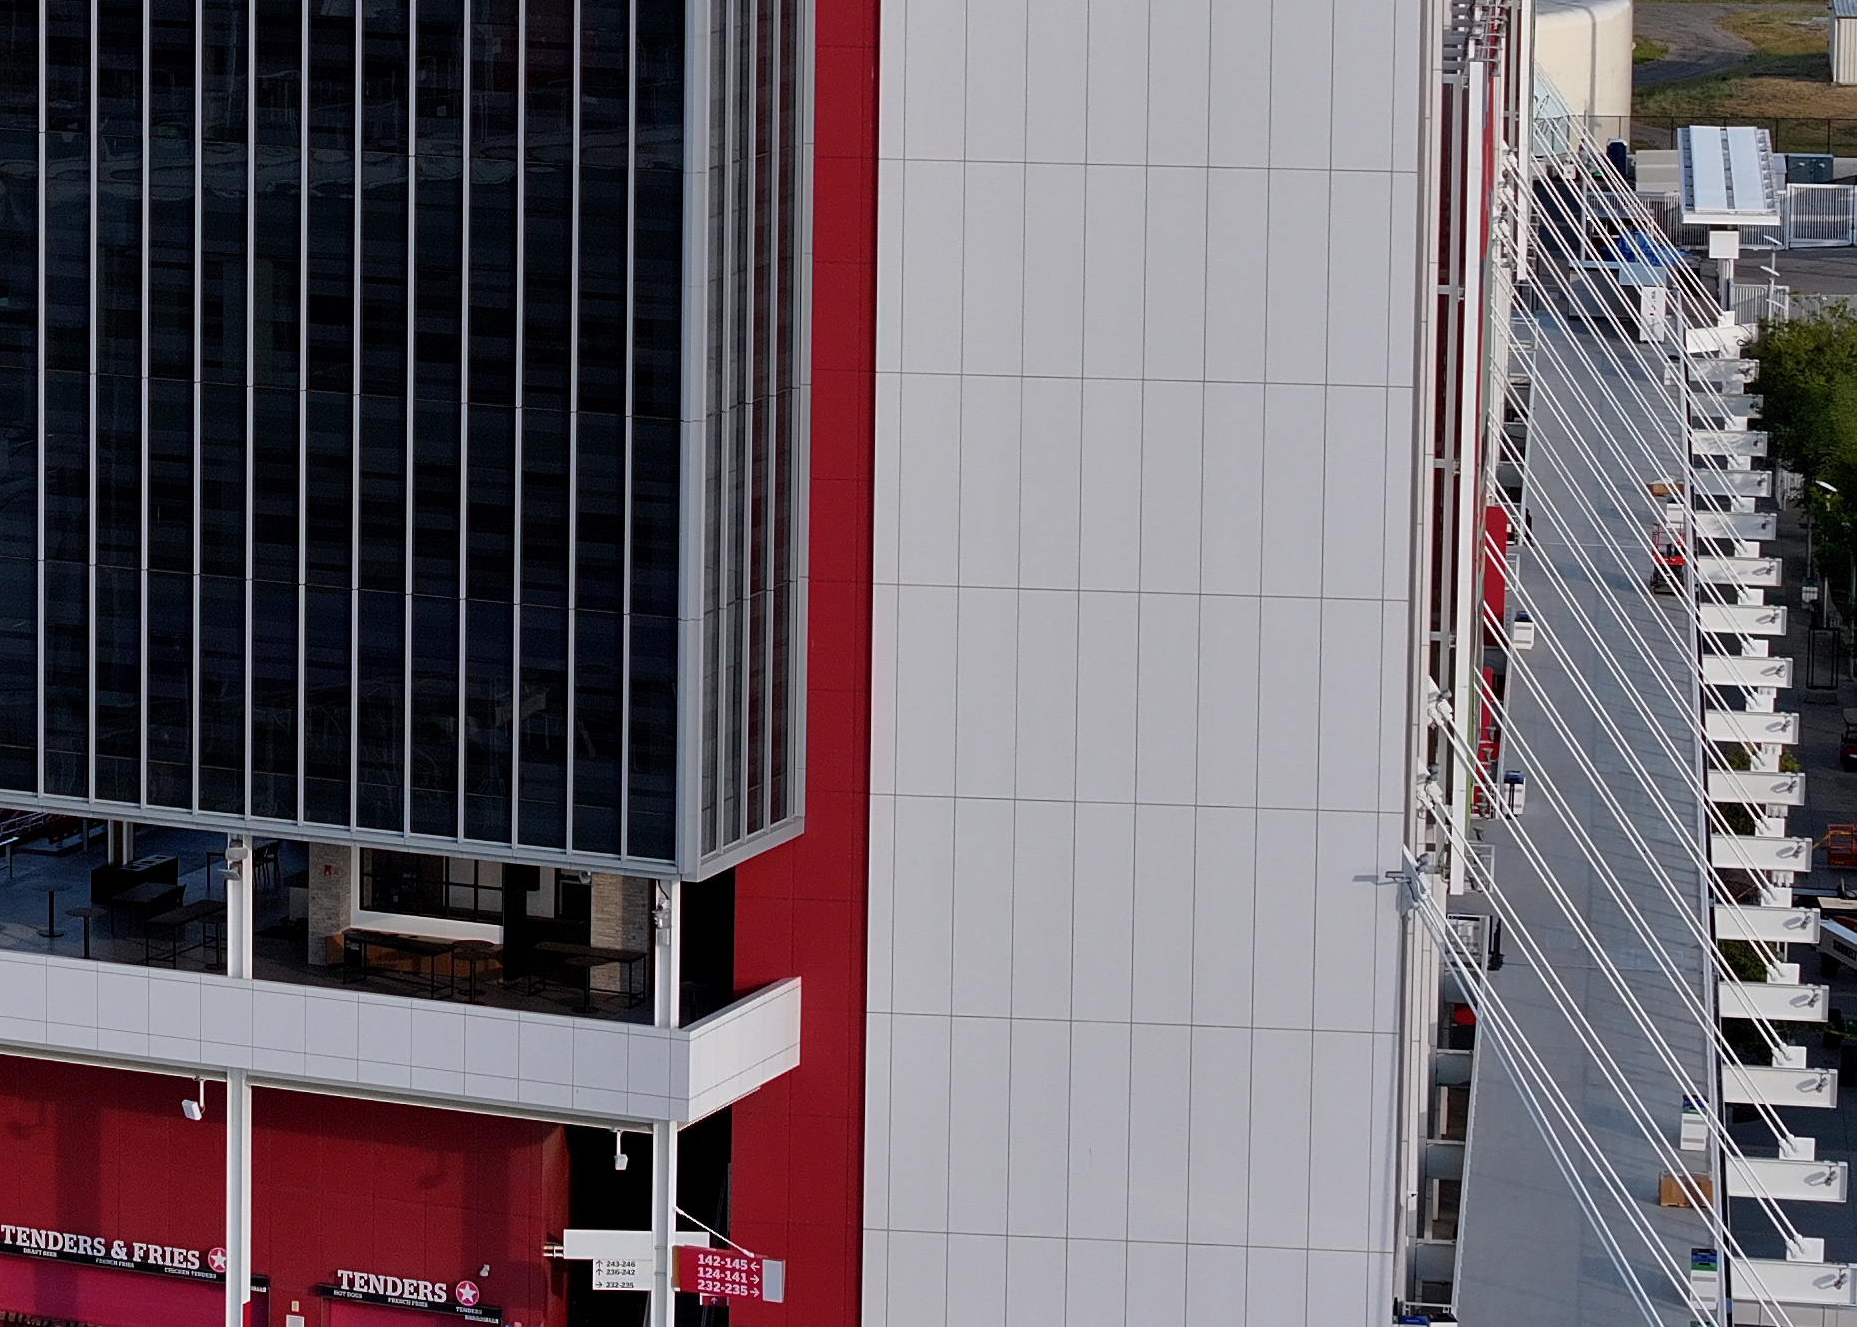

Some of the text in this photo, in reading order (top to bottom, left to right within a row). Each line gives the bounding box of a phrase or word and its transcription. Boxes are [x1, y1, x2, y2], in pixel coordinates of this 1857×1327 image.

[0, 1224, 201, 1270] TENDERS & FRIES
[697, 1254, 748, 1270] 142-145
[697, 1267, 748, 1284] 124-141
[337, 1269, 447, 1303] TENDERS
[697, 1279, 749, 1296] 232-235
